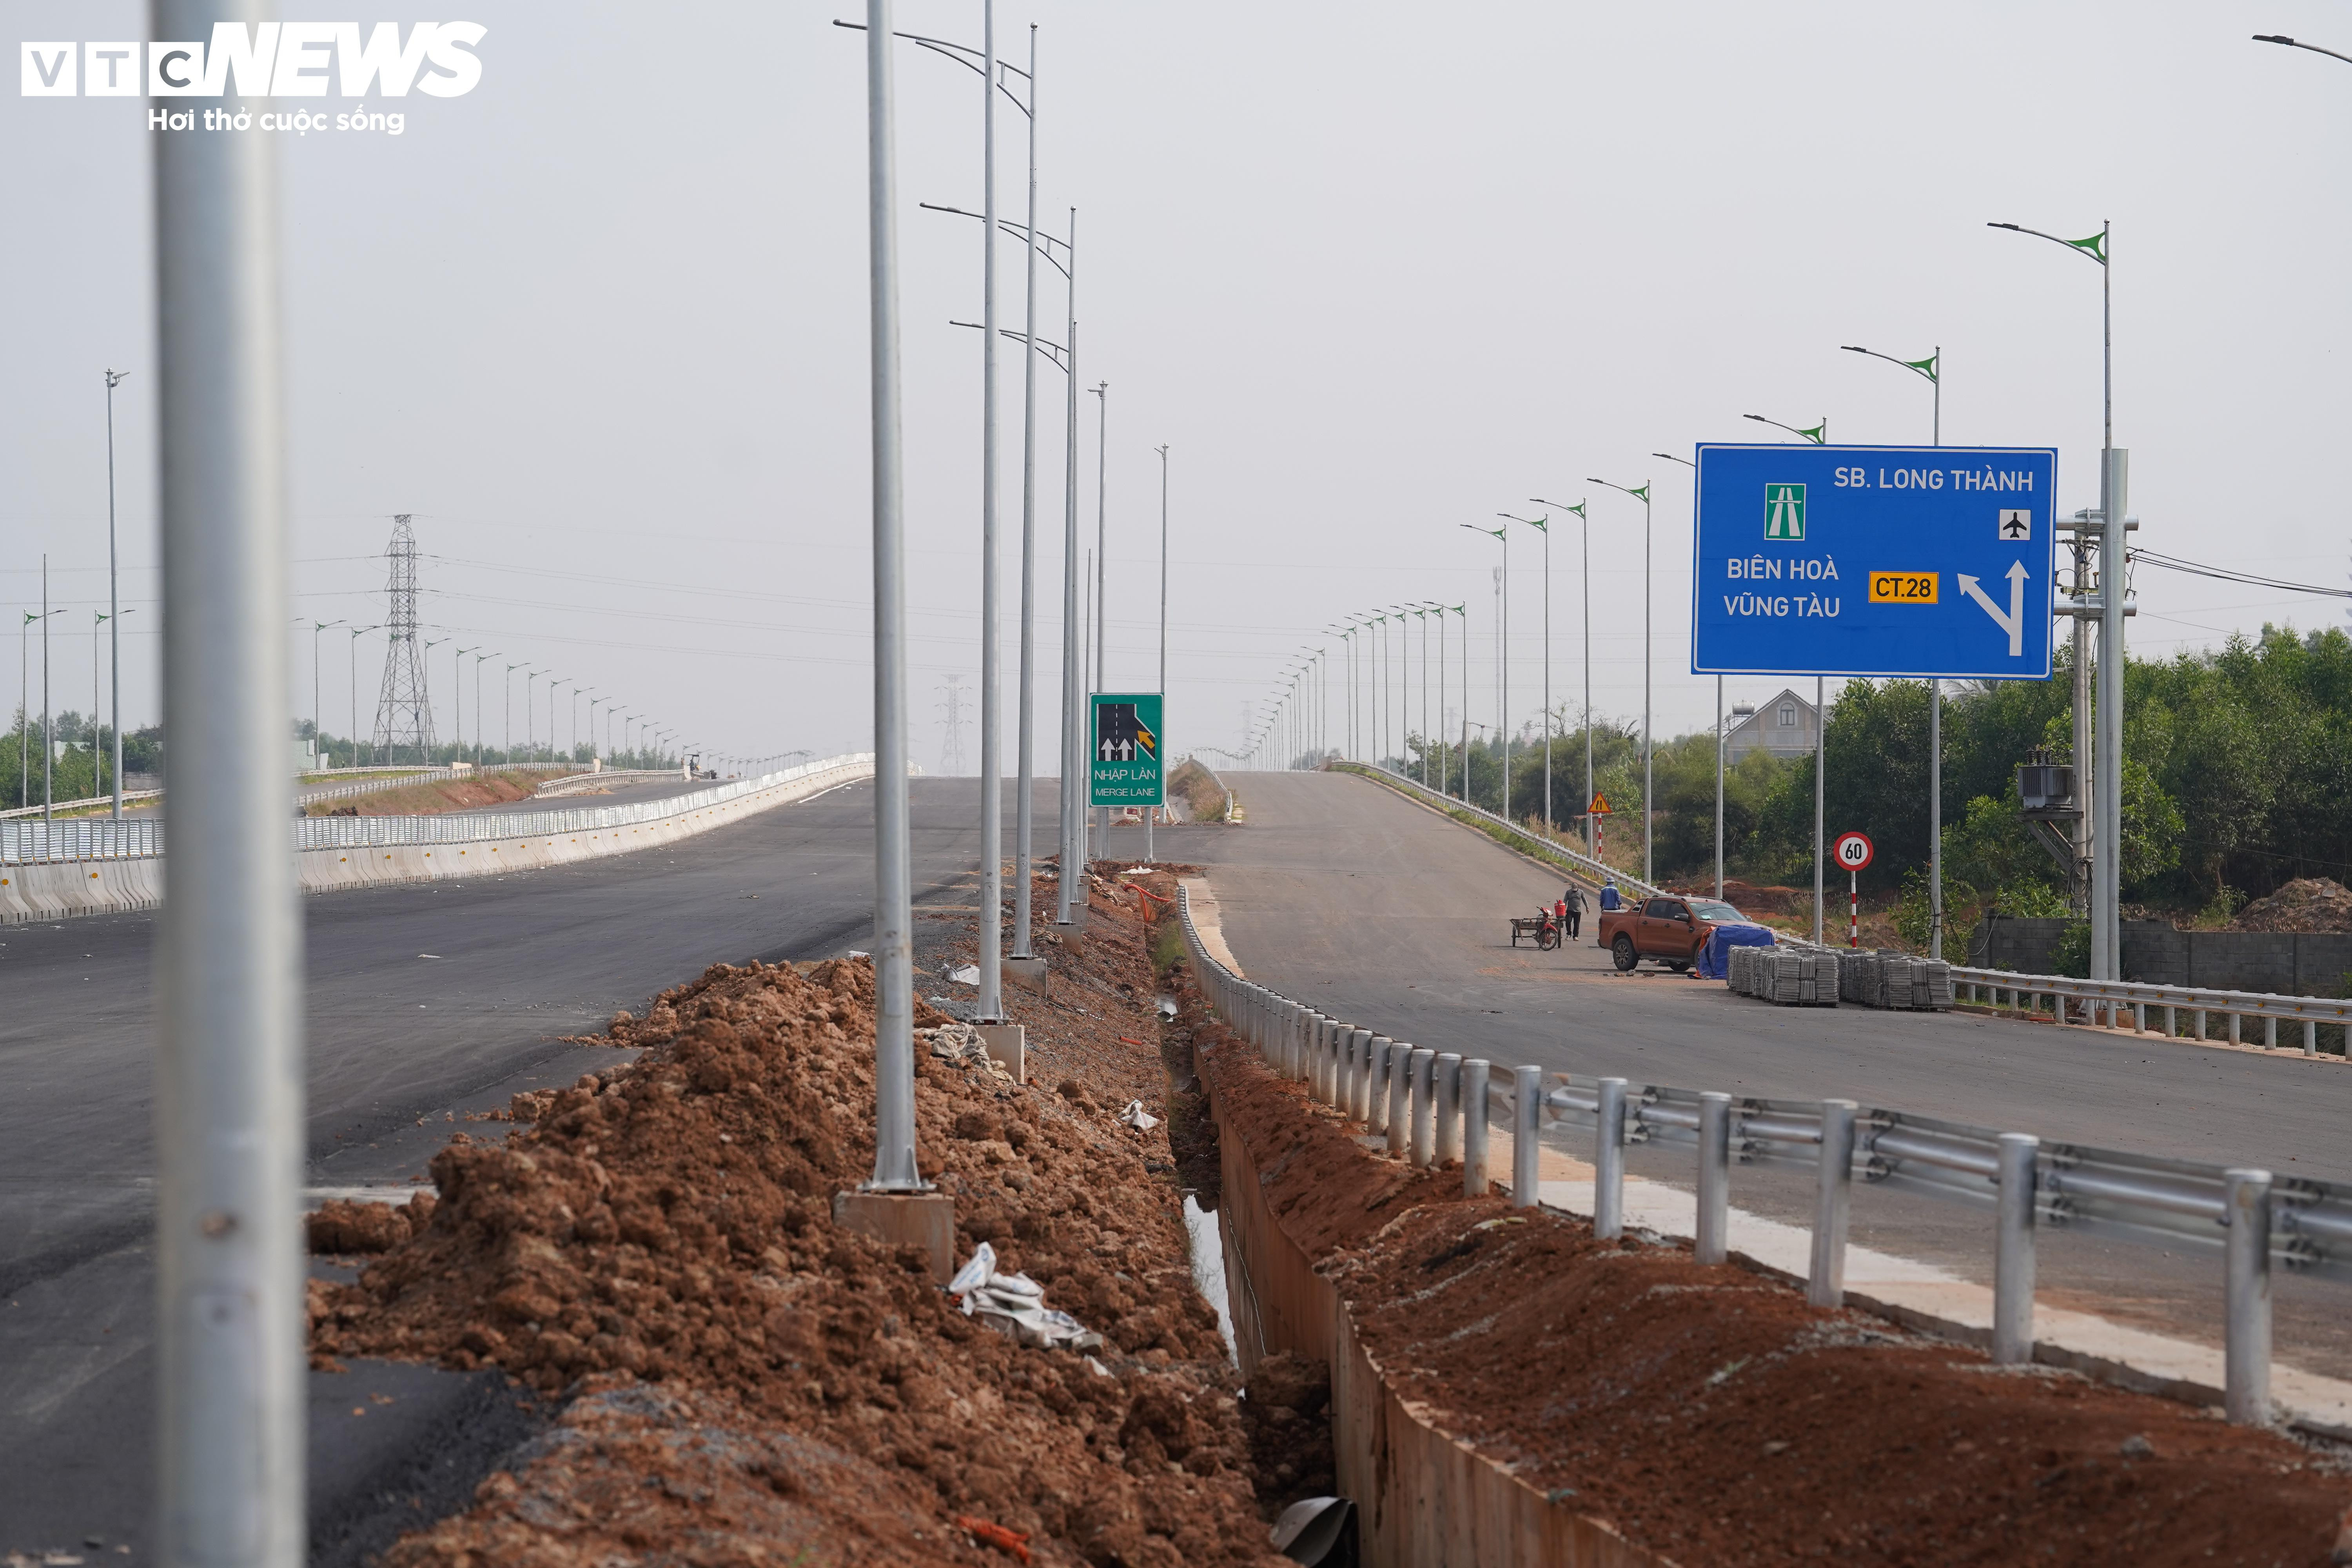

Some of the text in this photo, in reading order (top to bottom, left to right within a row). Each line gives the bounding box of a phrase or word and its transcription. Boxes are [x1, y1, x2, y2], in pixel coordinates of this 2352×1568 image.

[1834, 465, 2033, 491] SB. LONG THÀNH
[1728, 554, 1839, 580] BIÊN HOÀ
[1876, 577, 1931, 598] CT.28
[1724, 592, 1839, 617] VŨNG TÀU
[1095, 767, 1155, 782] NHẬP LÀN
[1096, 788, 1155, 796] MERGE LANE
[1846, 843, 1862, 859] 60
